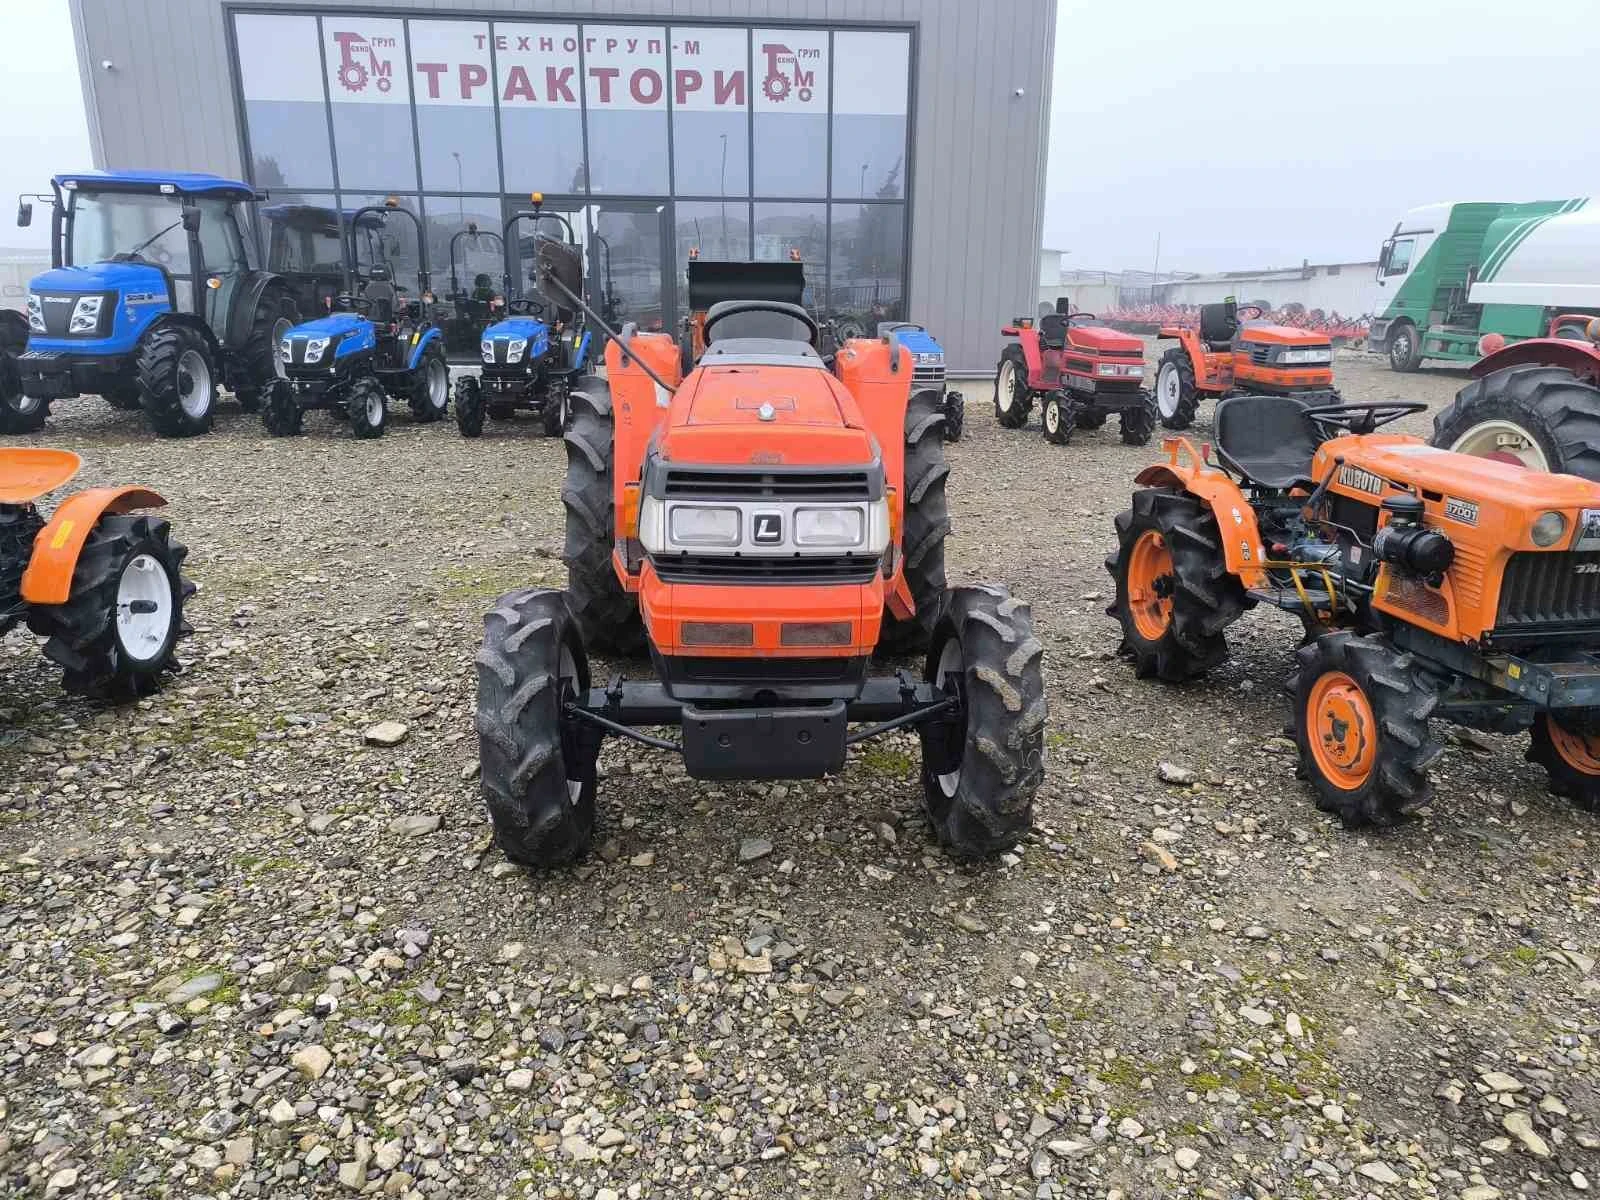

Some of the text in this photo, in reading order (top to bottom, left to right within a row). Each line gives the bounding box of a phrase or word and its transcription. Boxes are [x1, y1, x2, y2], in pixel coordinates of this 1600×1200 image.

[473, 34, 701, 55] ТЕХНОГРУП-М
[416, 63, 746, 106] ТРАКТОРИ
[1338, 465, 1382, 495] KUBOTA
[757, 519, 778, 537] L
